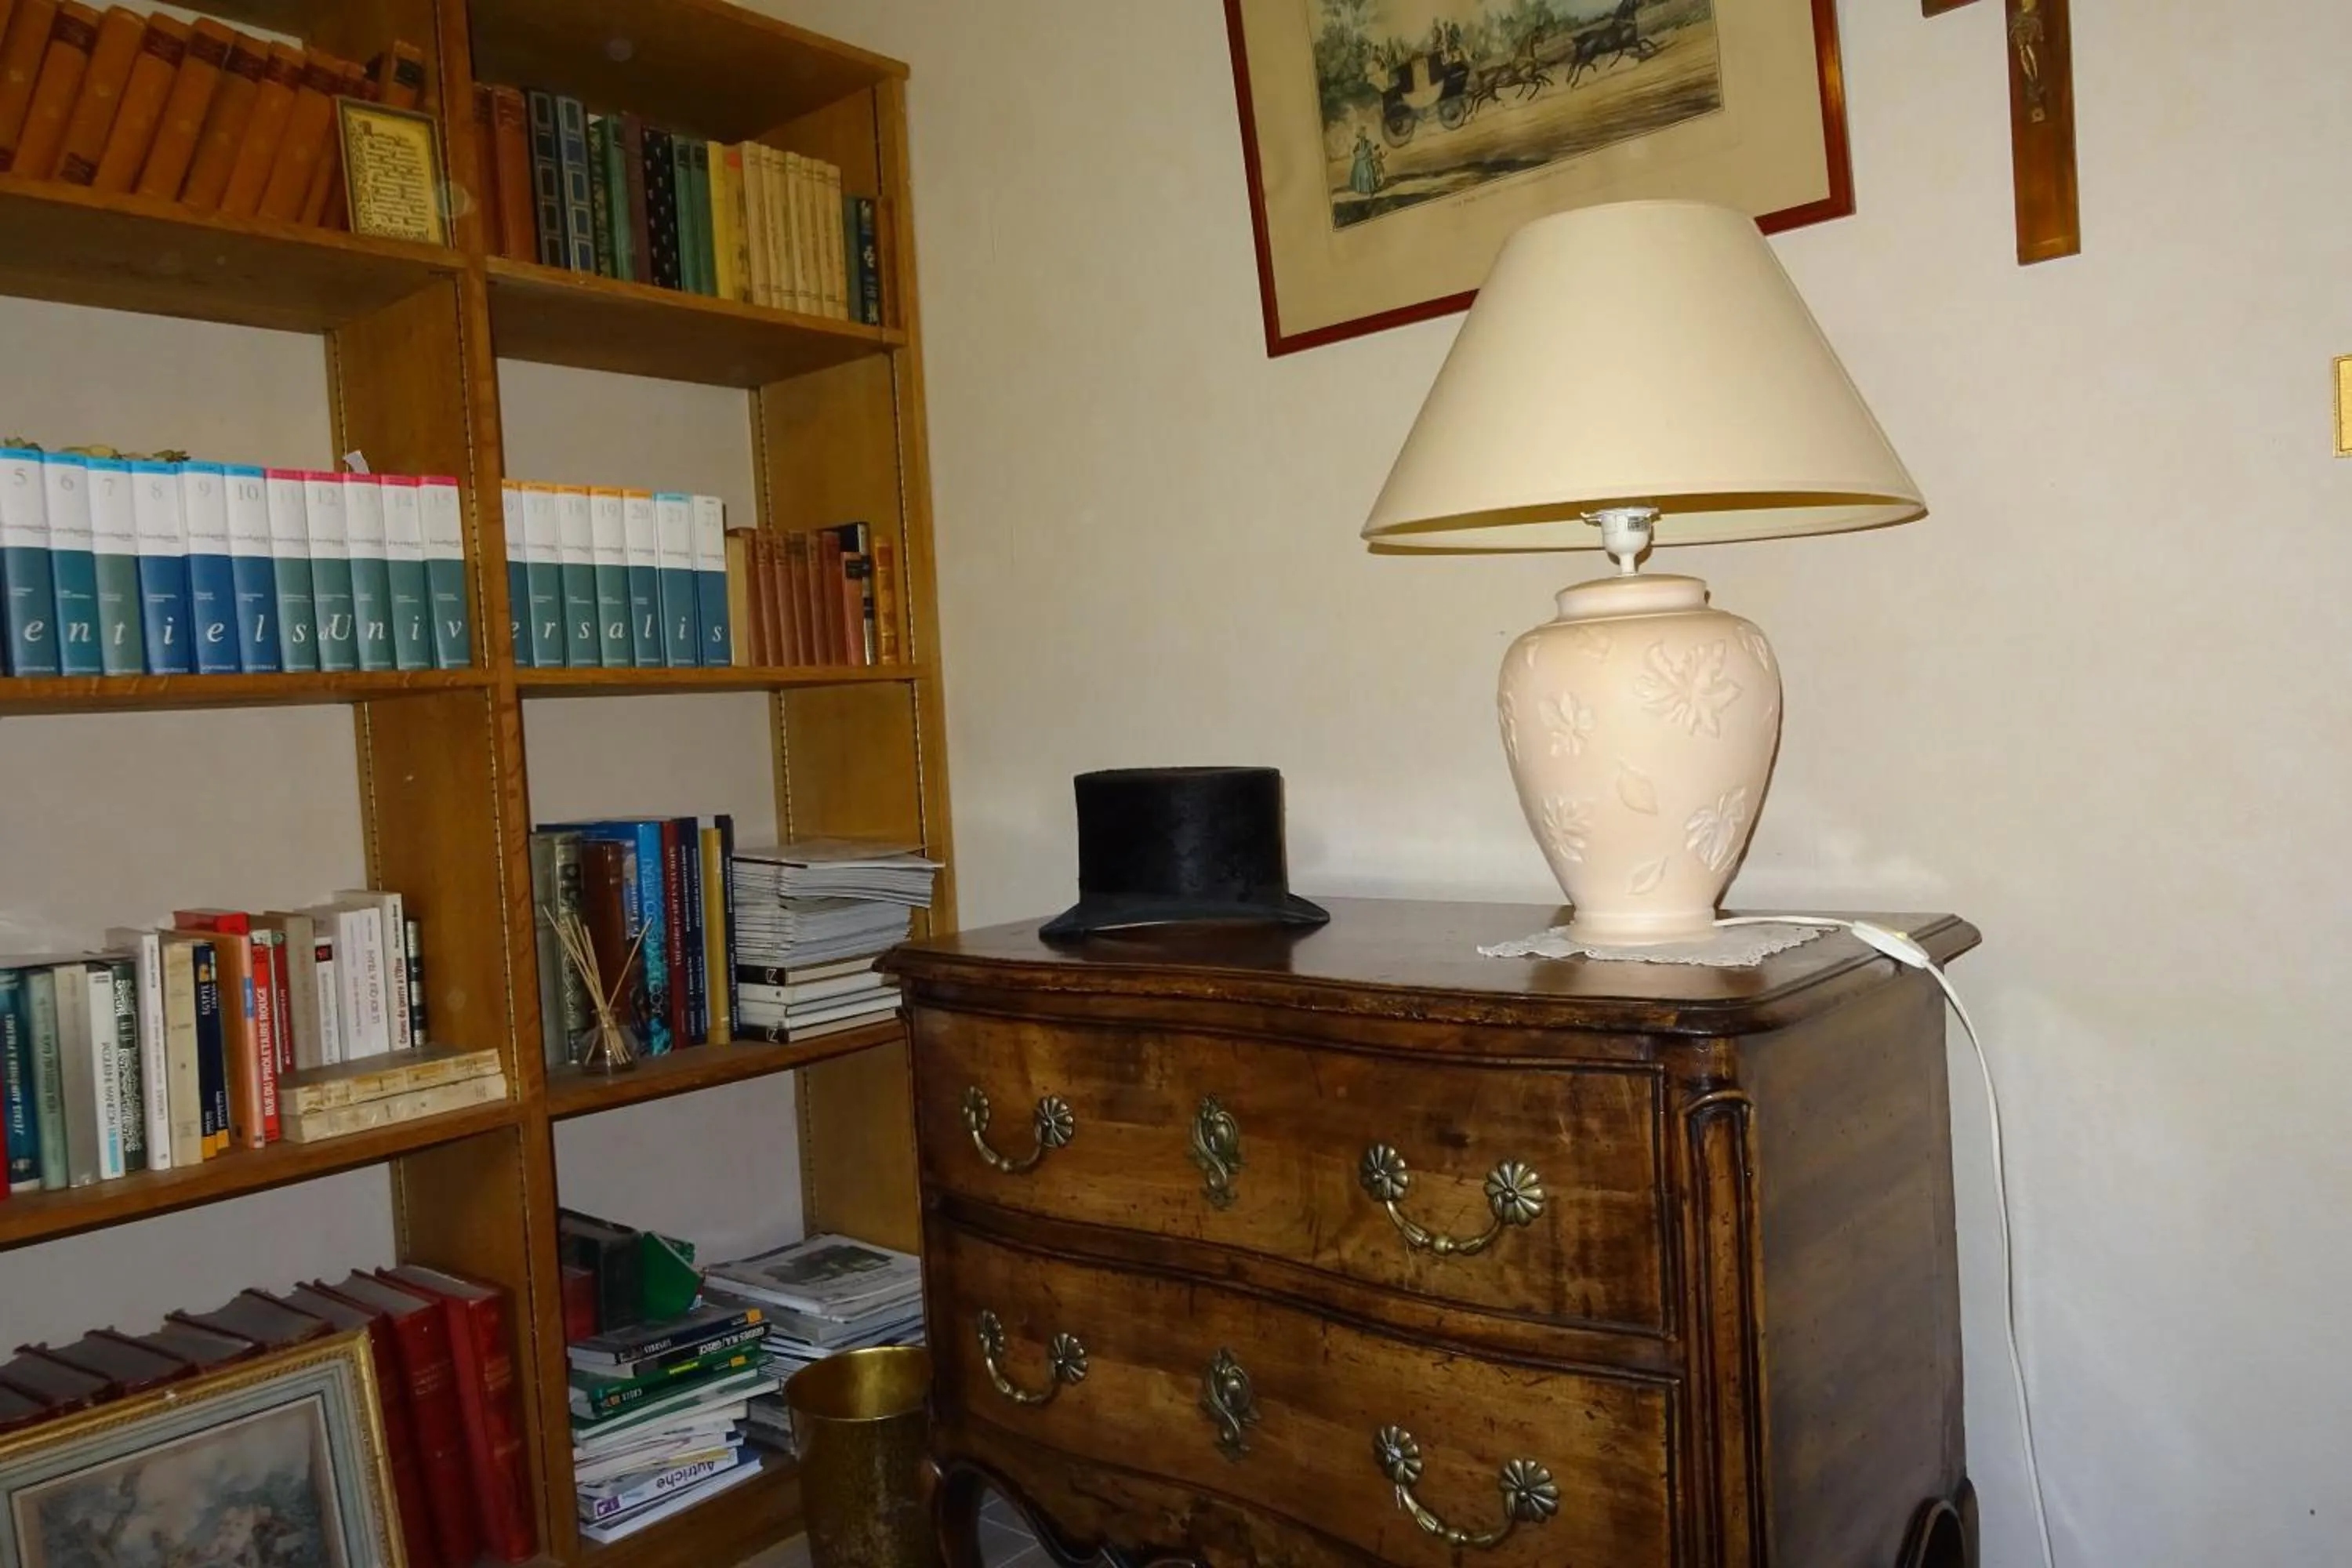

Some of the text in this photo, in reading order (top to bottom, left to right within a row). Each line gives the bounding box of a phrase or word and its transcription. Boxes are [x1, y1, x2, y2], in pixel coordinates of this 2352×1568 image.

[13, 468, 27, 487] 5
[60, 474, 74, 491] 6
[102, 477, 115, 497] 7
[151, 483, 163, 500] 8
[198, 481, 212, 497] 9
[238, 483, 260, 502] 10
[318, 486, 338, 506] 12
[655, 1461, 715, 1489] Autriche
